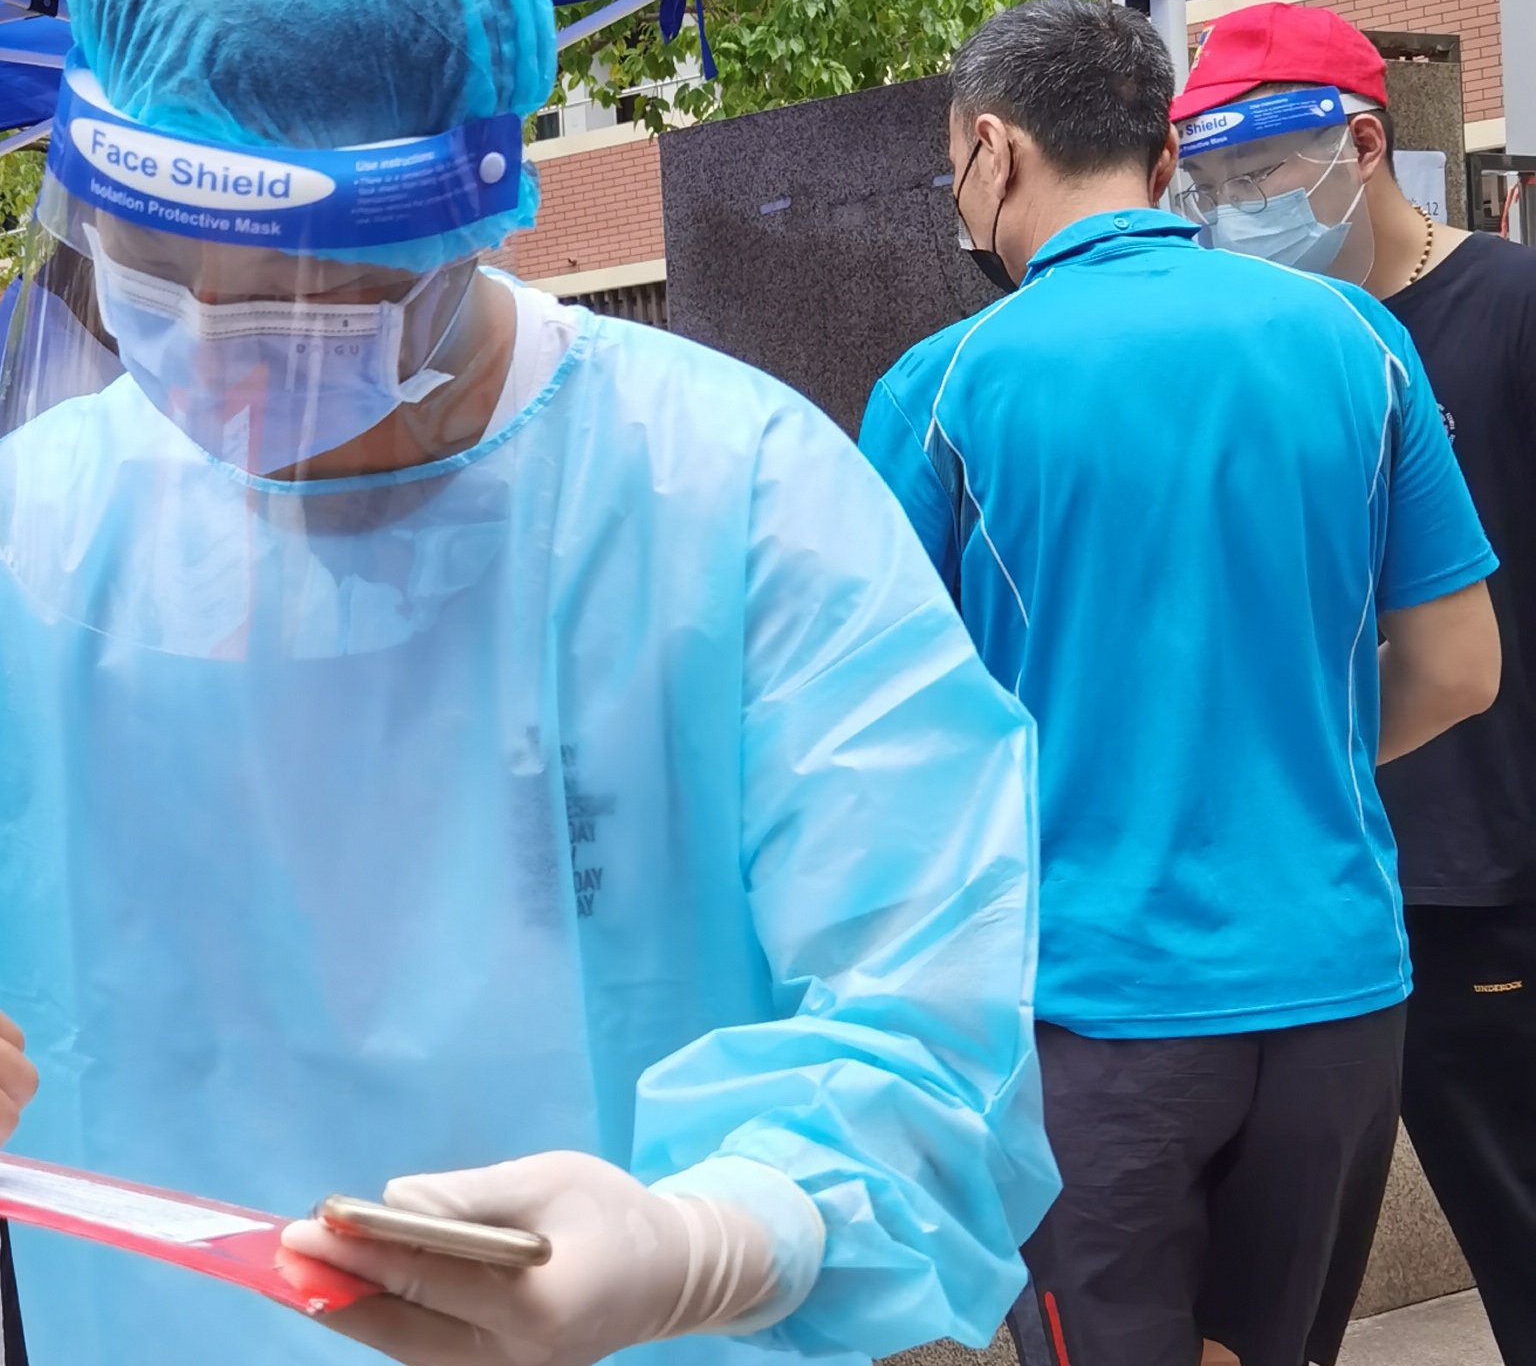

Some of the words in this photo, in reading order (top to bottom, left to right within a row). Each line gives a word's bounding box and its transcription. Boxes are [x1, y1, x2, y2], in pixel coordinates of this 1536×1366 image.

[1185, 116, 1228, 136] Shield
[90, 128, 158, 178] Face
[170, 156, 292, 199] Shield
[90, 177, 145, 213] Isolation
[148, 200, 231, 231] Protective
[234, 217, 282, 236] Mask
